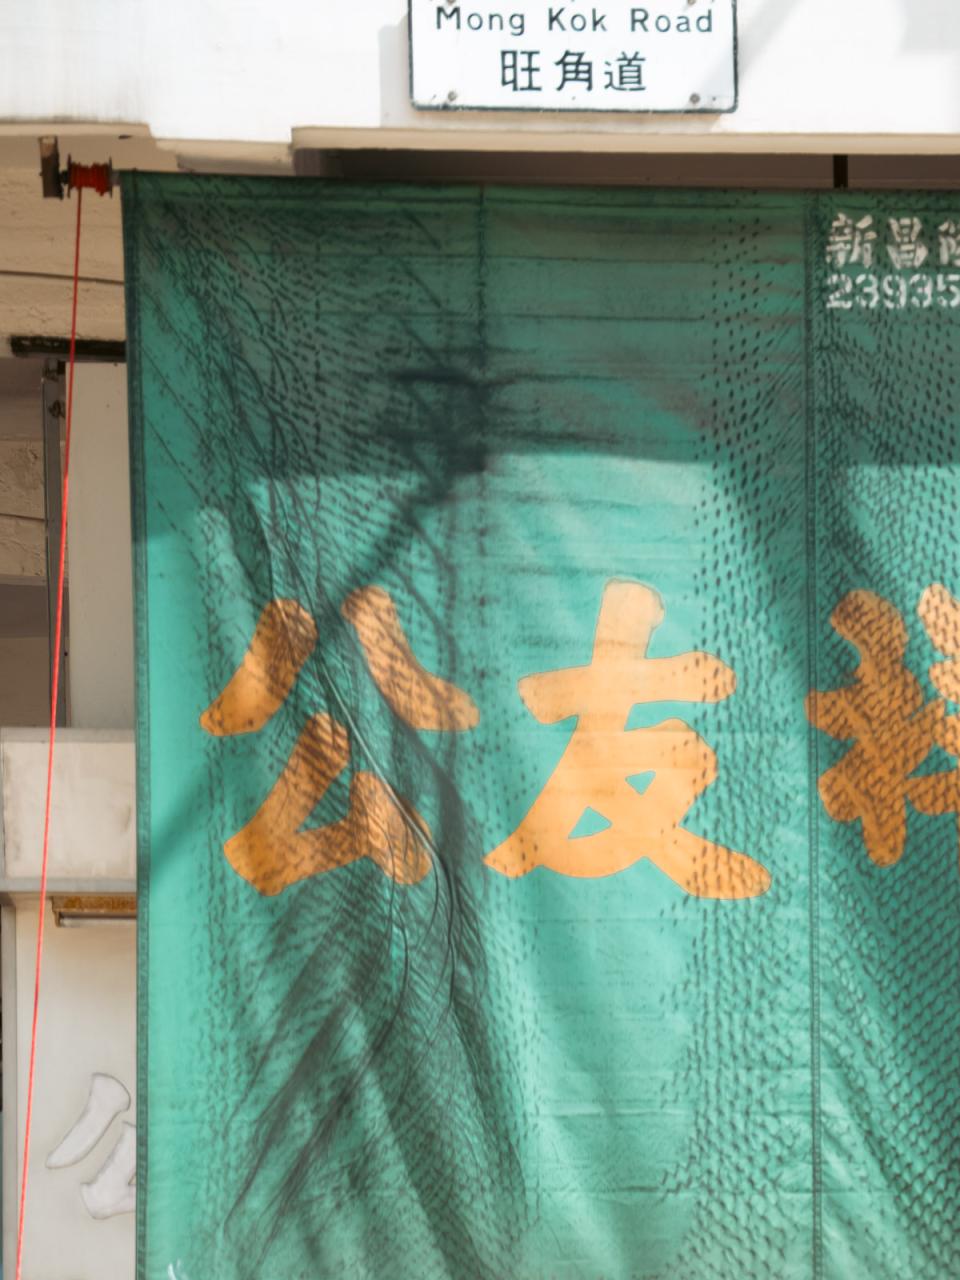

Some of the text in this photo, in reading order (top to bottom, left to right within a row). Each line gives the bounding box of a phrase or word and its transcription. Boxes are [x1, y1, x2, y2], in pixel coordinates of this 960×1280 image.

[436, 7, 713, 36] Mong Kok Road
[500, 48, 647, 93] 旺角道
